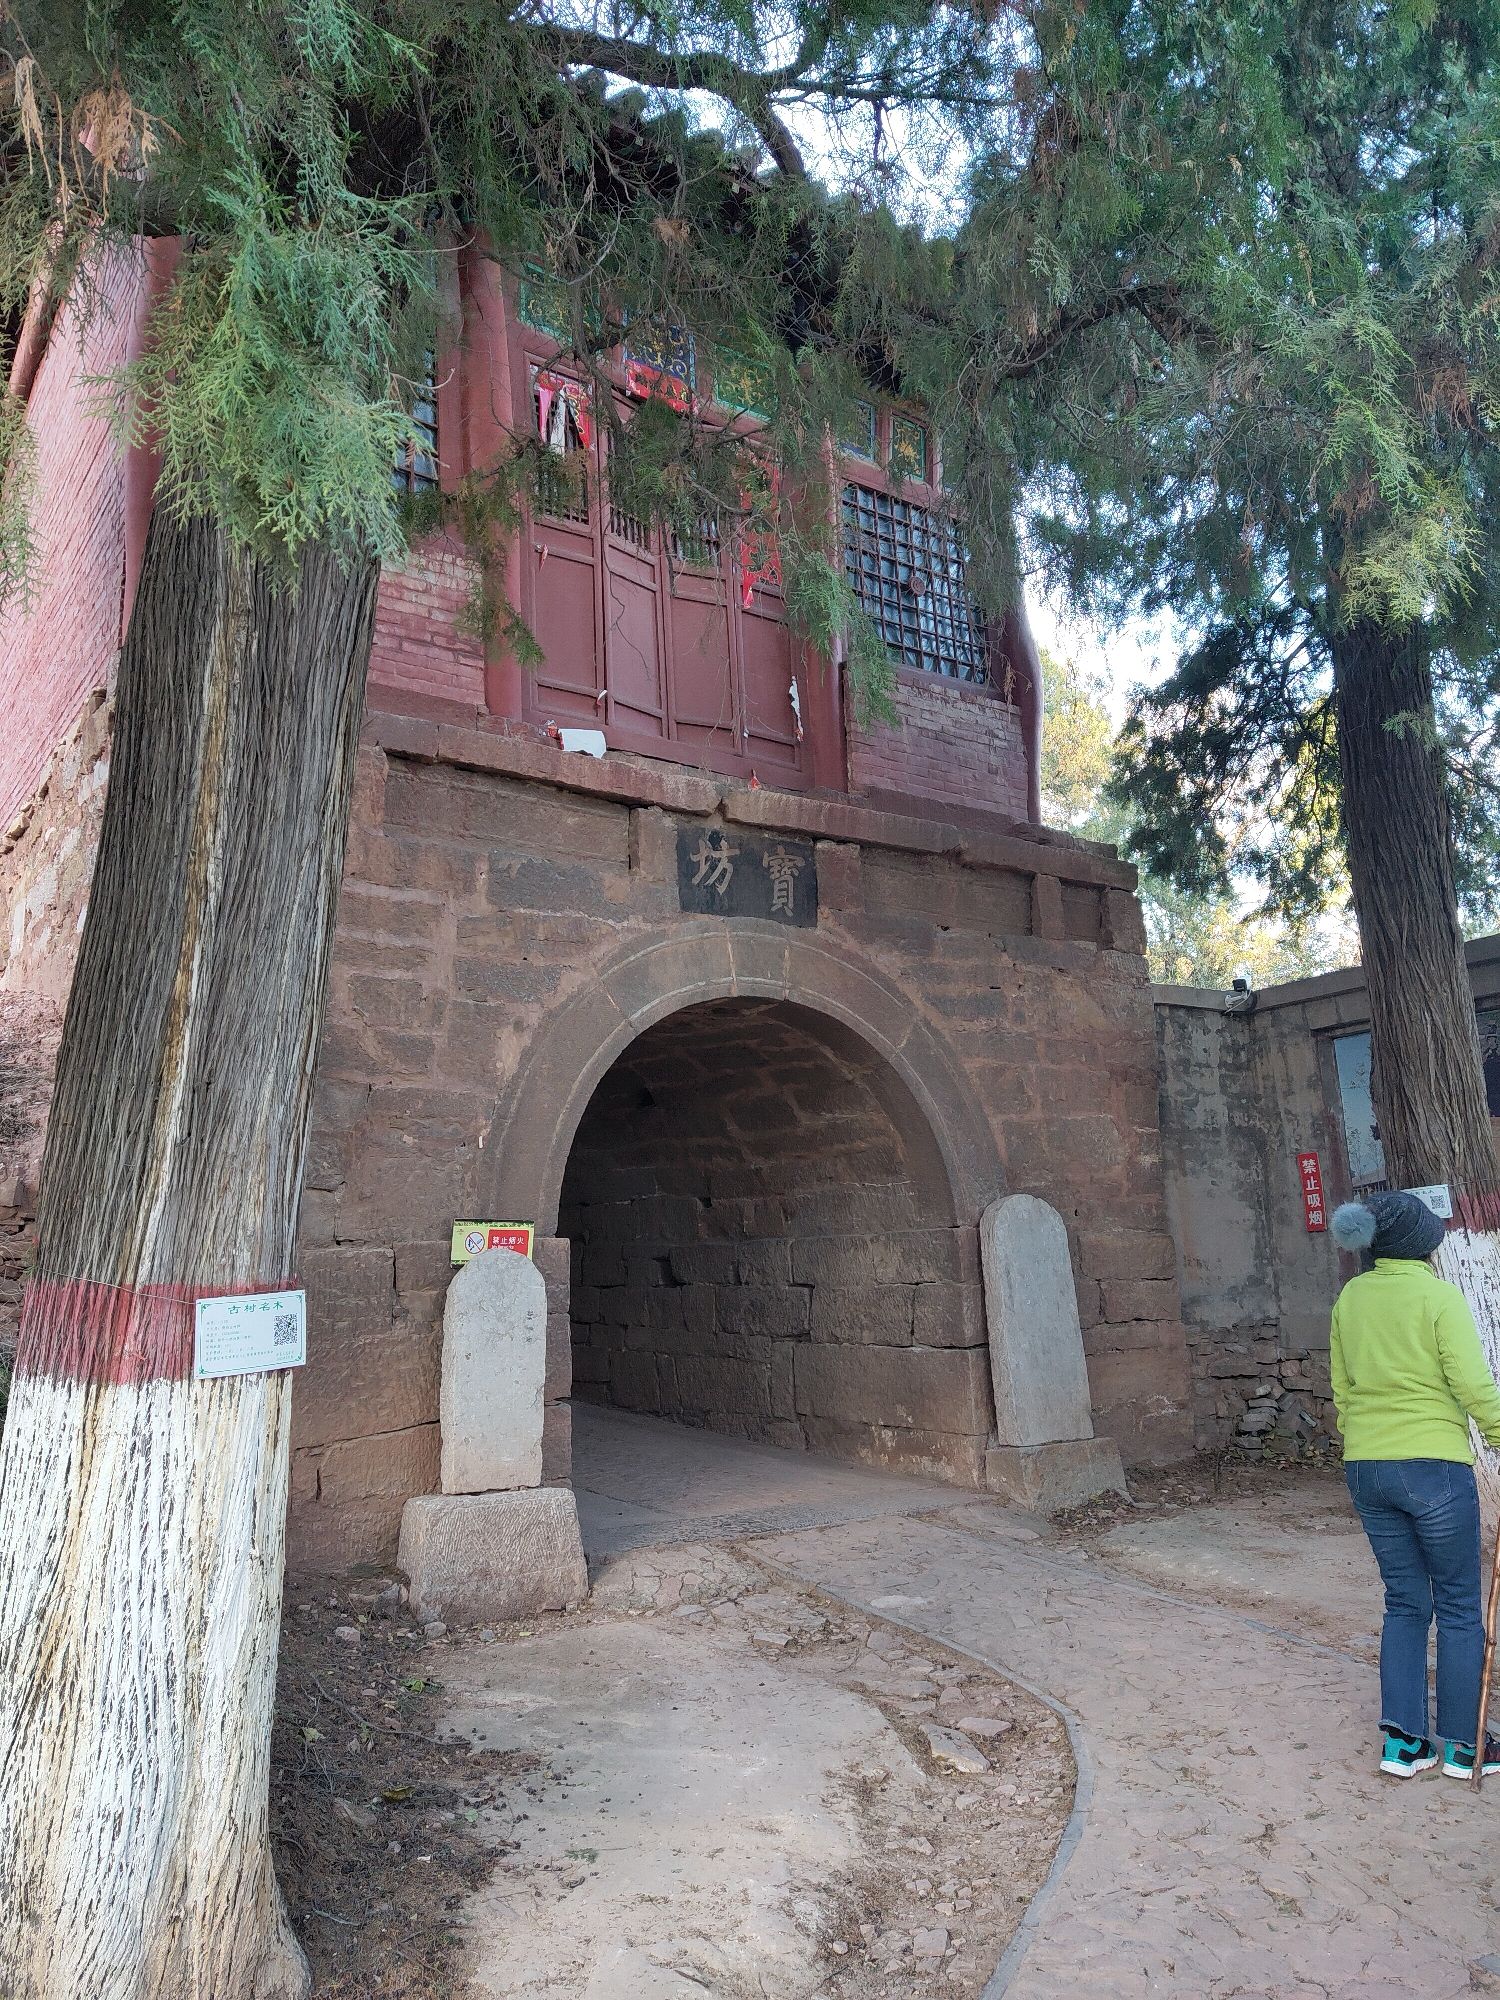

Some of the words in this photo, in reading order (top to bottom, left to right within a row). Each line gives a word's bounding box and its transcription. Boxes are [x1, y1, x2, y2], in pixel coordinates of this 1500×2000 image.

[1301, 1158, 1323, 1226] 禁止吸烟
[492, 1235, 525, 1246] 禁止烟火
[227, 1300, 284, 1315] 古树名木
